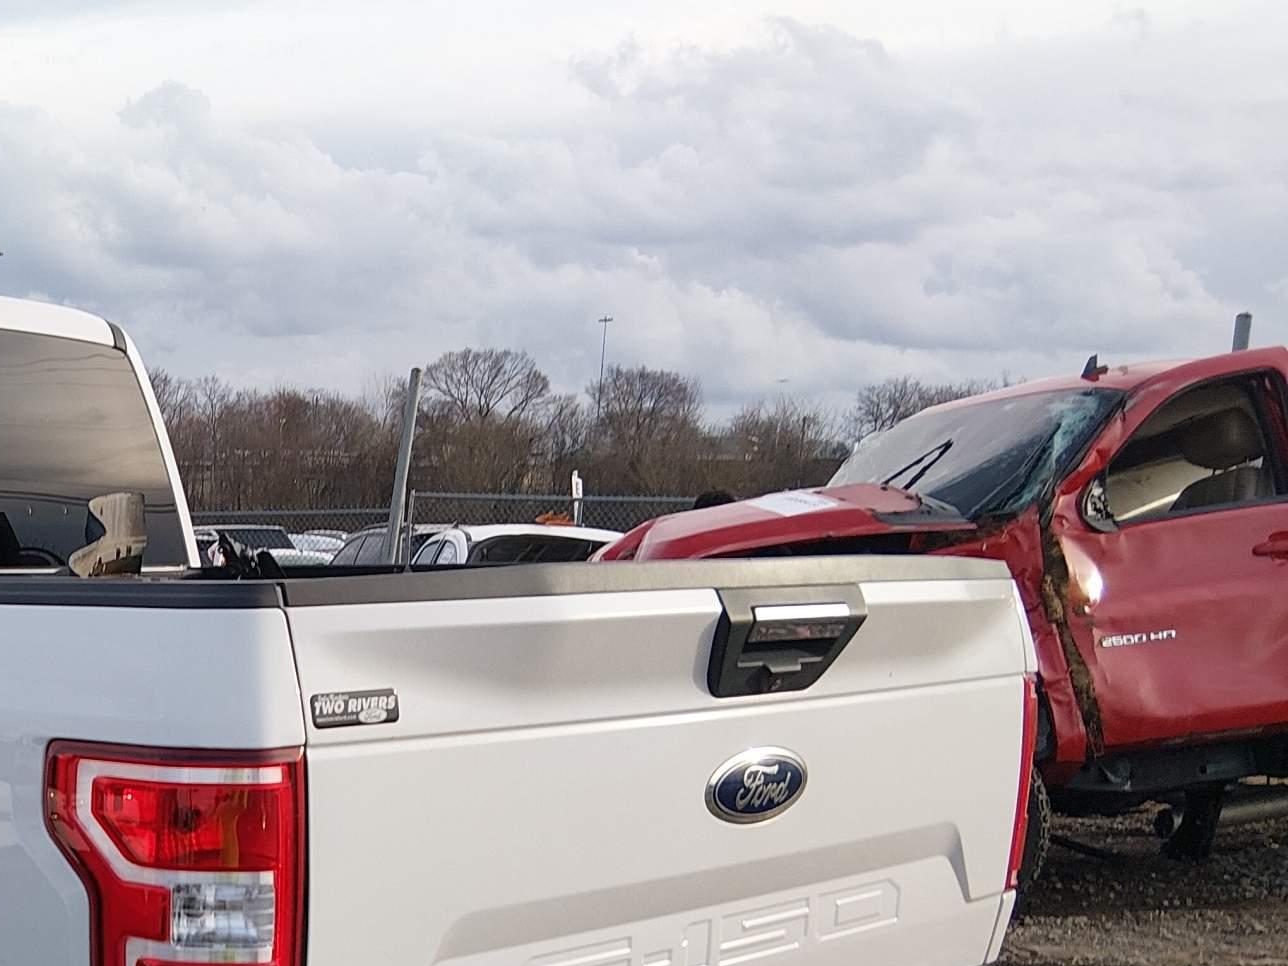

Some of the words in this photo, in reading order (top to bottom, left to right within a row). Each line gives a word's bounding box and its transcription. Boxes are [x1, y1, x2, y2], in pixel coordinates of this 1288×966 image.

[314, 699, 345, 716] TWO
[347, 695, 396, 713] RIVERS
[735, 764, 792, 810] Ford
